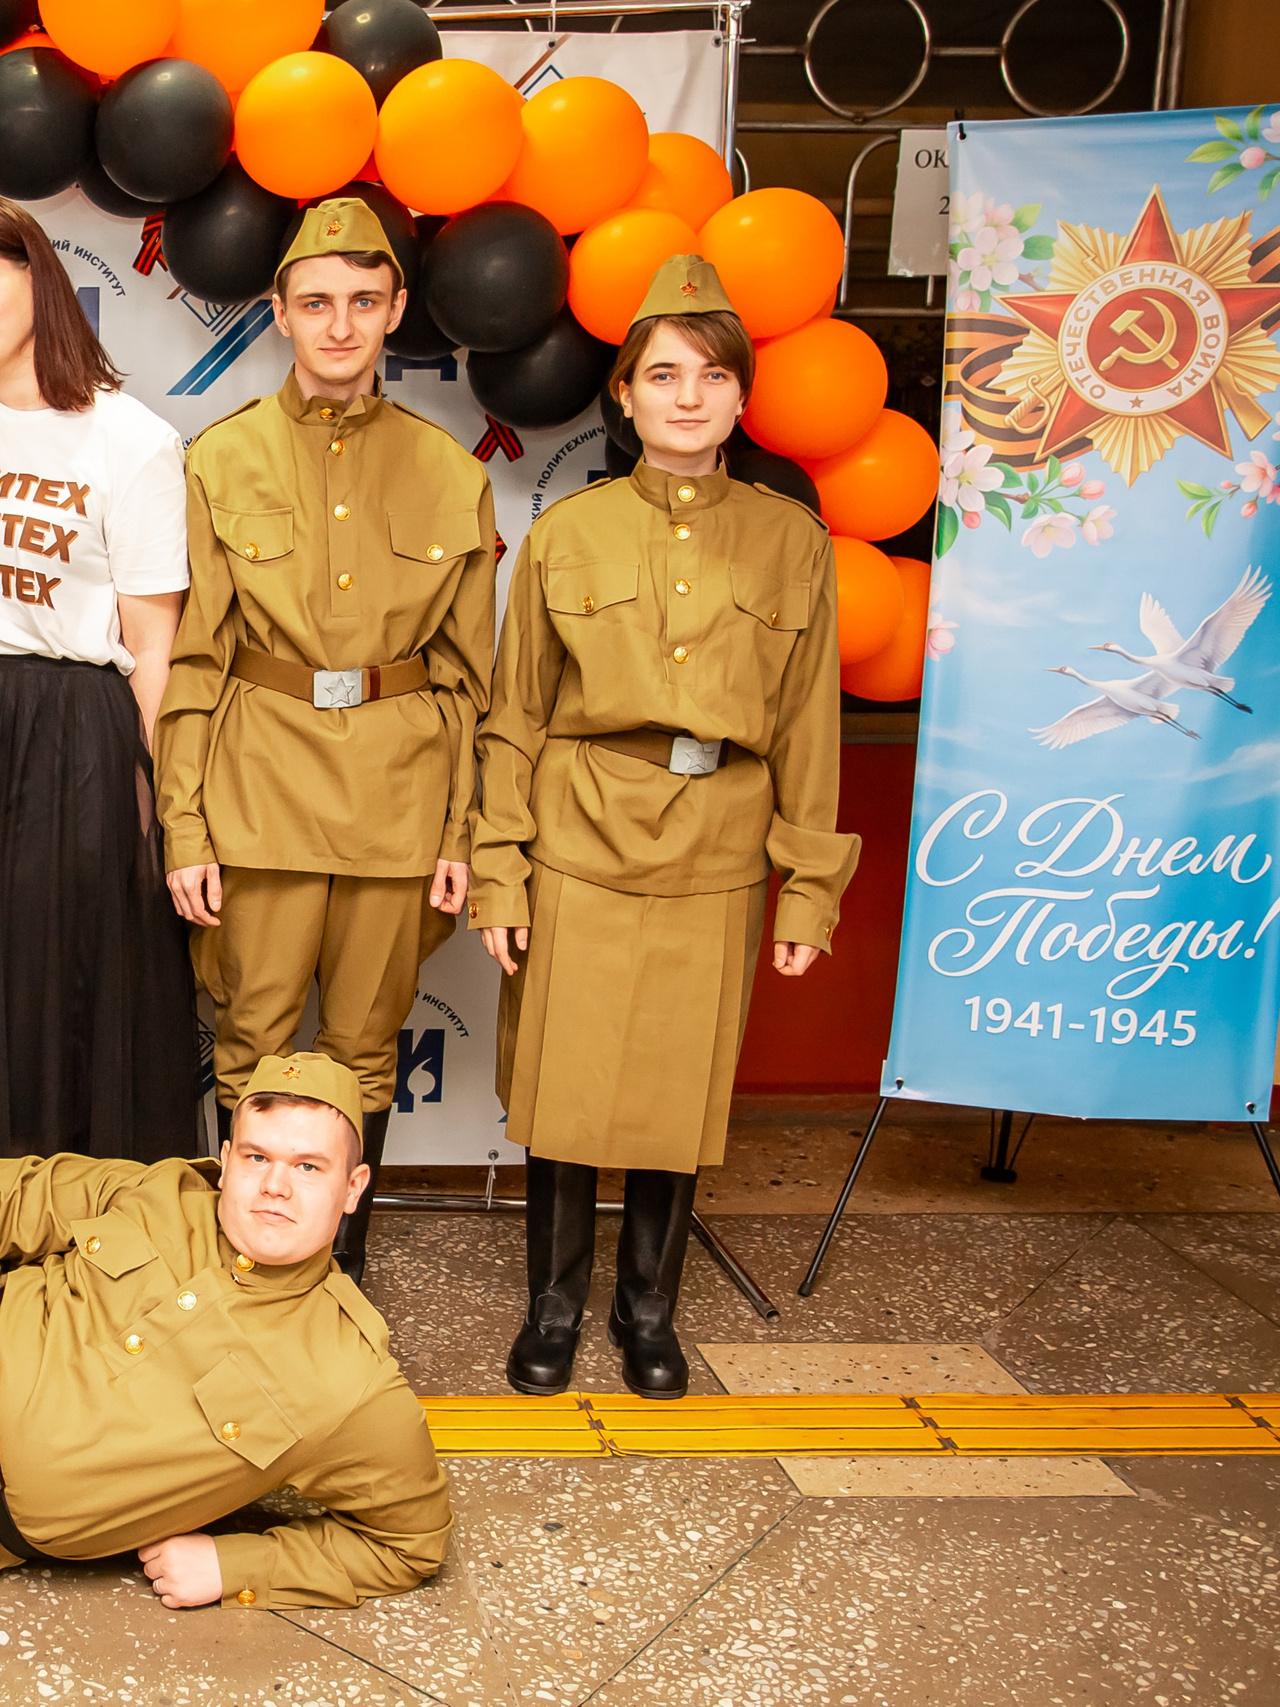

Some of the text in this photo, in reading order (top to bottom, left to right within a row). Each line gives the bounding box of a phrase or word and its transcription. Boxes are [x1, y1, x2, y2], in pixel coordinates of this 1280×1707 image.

[914, 149, 949, 169] ОК
[73, 245, 126, 297] ИНСТИТУТ
[1066, 268, 1221, 400] ОТЕЧЕСТВЕННАЯ ВОЙНА
[537, 425, 607, 489] ПОЛИТЕХНИЧ
[915, 789, 1272, 887] С Днем
[928, 884, 1280, 1000] Победы!
[422, 992, 470, 1038] ИНСТИТУТ
[964, 995, 1198, 1047] 1941-1945
